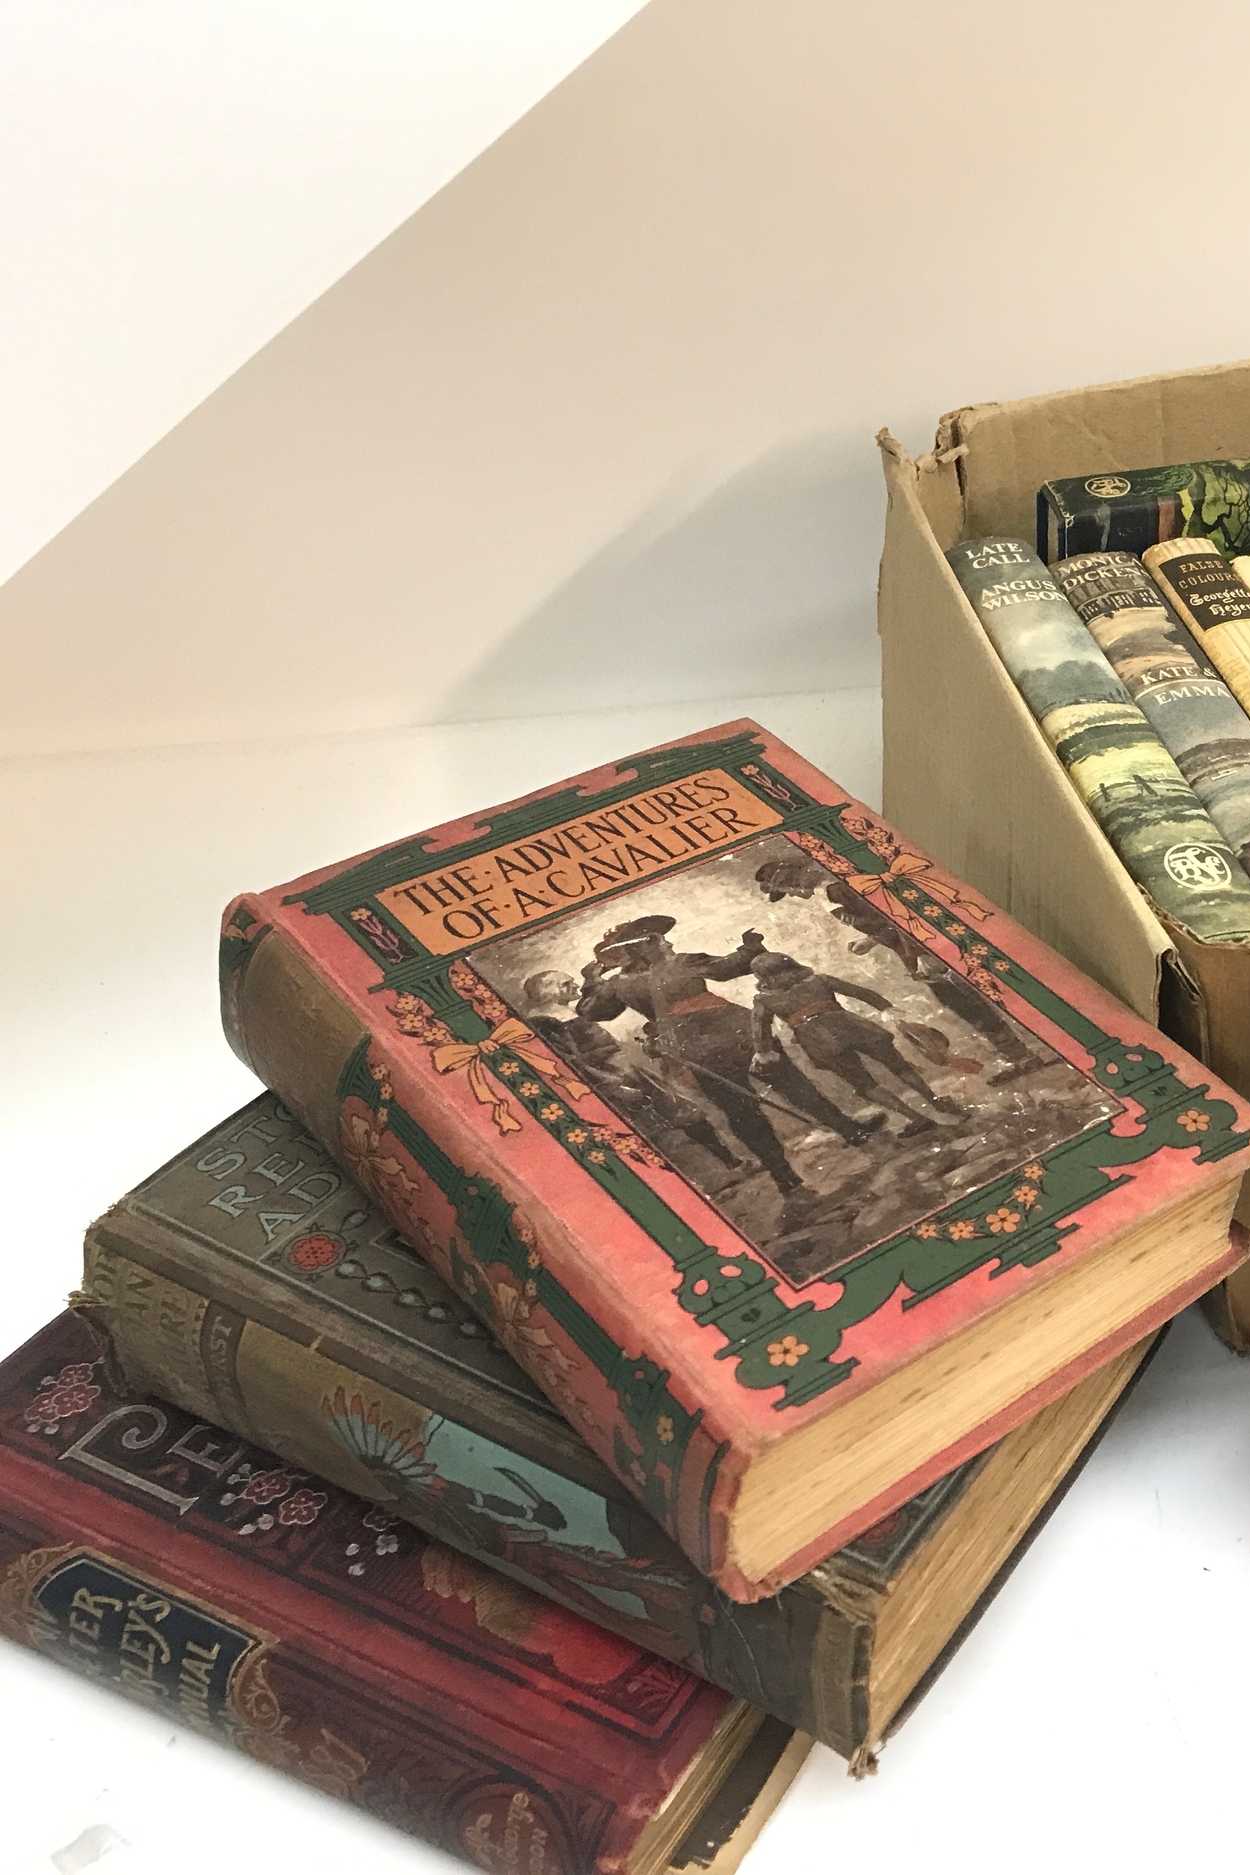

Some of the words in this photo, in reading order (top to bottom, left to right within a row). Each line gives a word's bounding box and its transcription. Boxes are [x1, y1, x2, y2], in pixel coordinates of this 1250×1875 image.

[965, 542, 1023, 560] LATE
[972, 553, 1030, 570] CALL
[1058, 555, 1142, 577] MONICA
[1178, 560, 1224, 574] FALSE
[981, 580, 1056, 600] ANGUS
[981, 591, 1069, 611] WILSON
[1140, 667, 1198, 685] KATE
[1203, 667, 1217, 678] &
[1154, 686, 1230, 705] EMMA
[393, 865, 493, 916] THE
[493, 777, 731, 883] ADVENTURES
[442, 898, 504, 939] OF
[512, 888, 554, 918] A
[547, 807, 760, 899] CAVALIER
